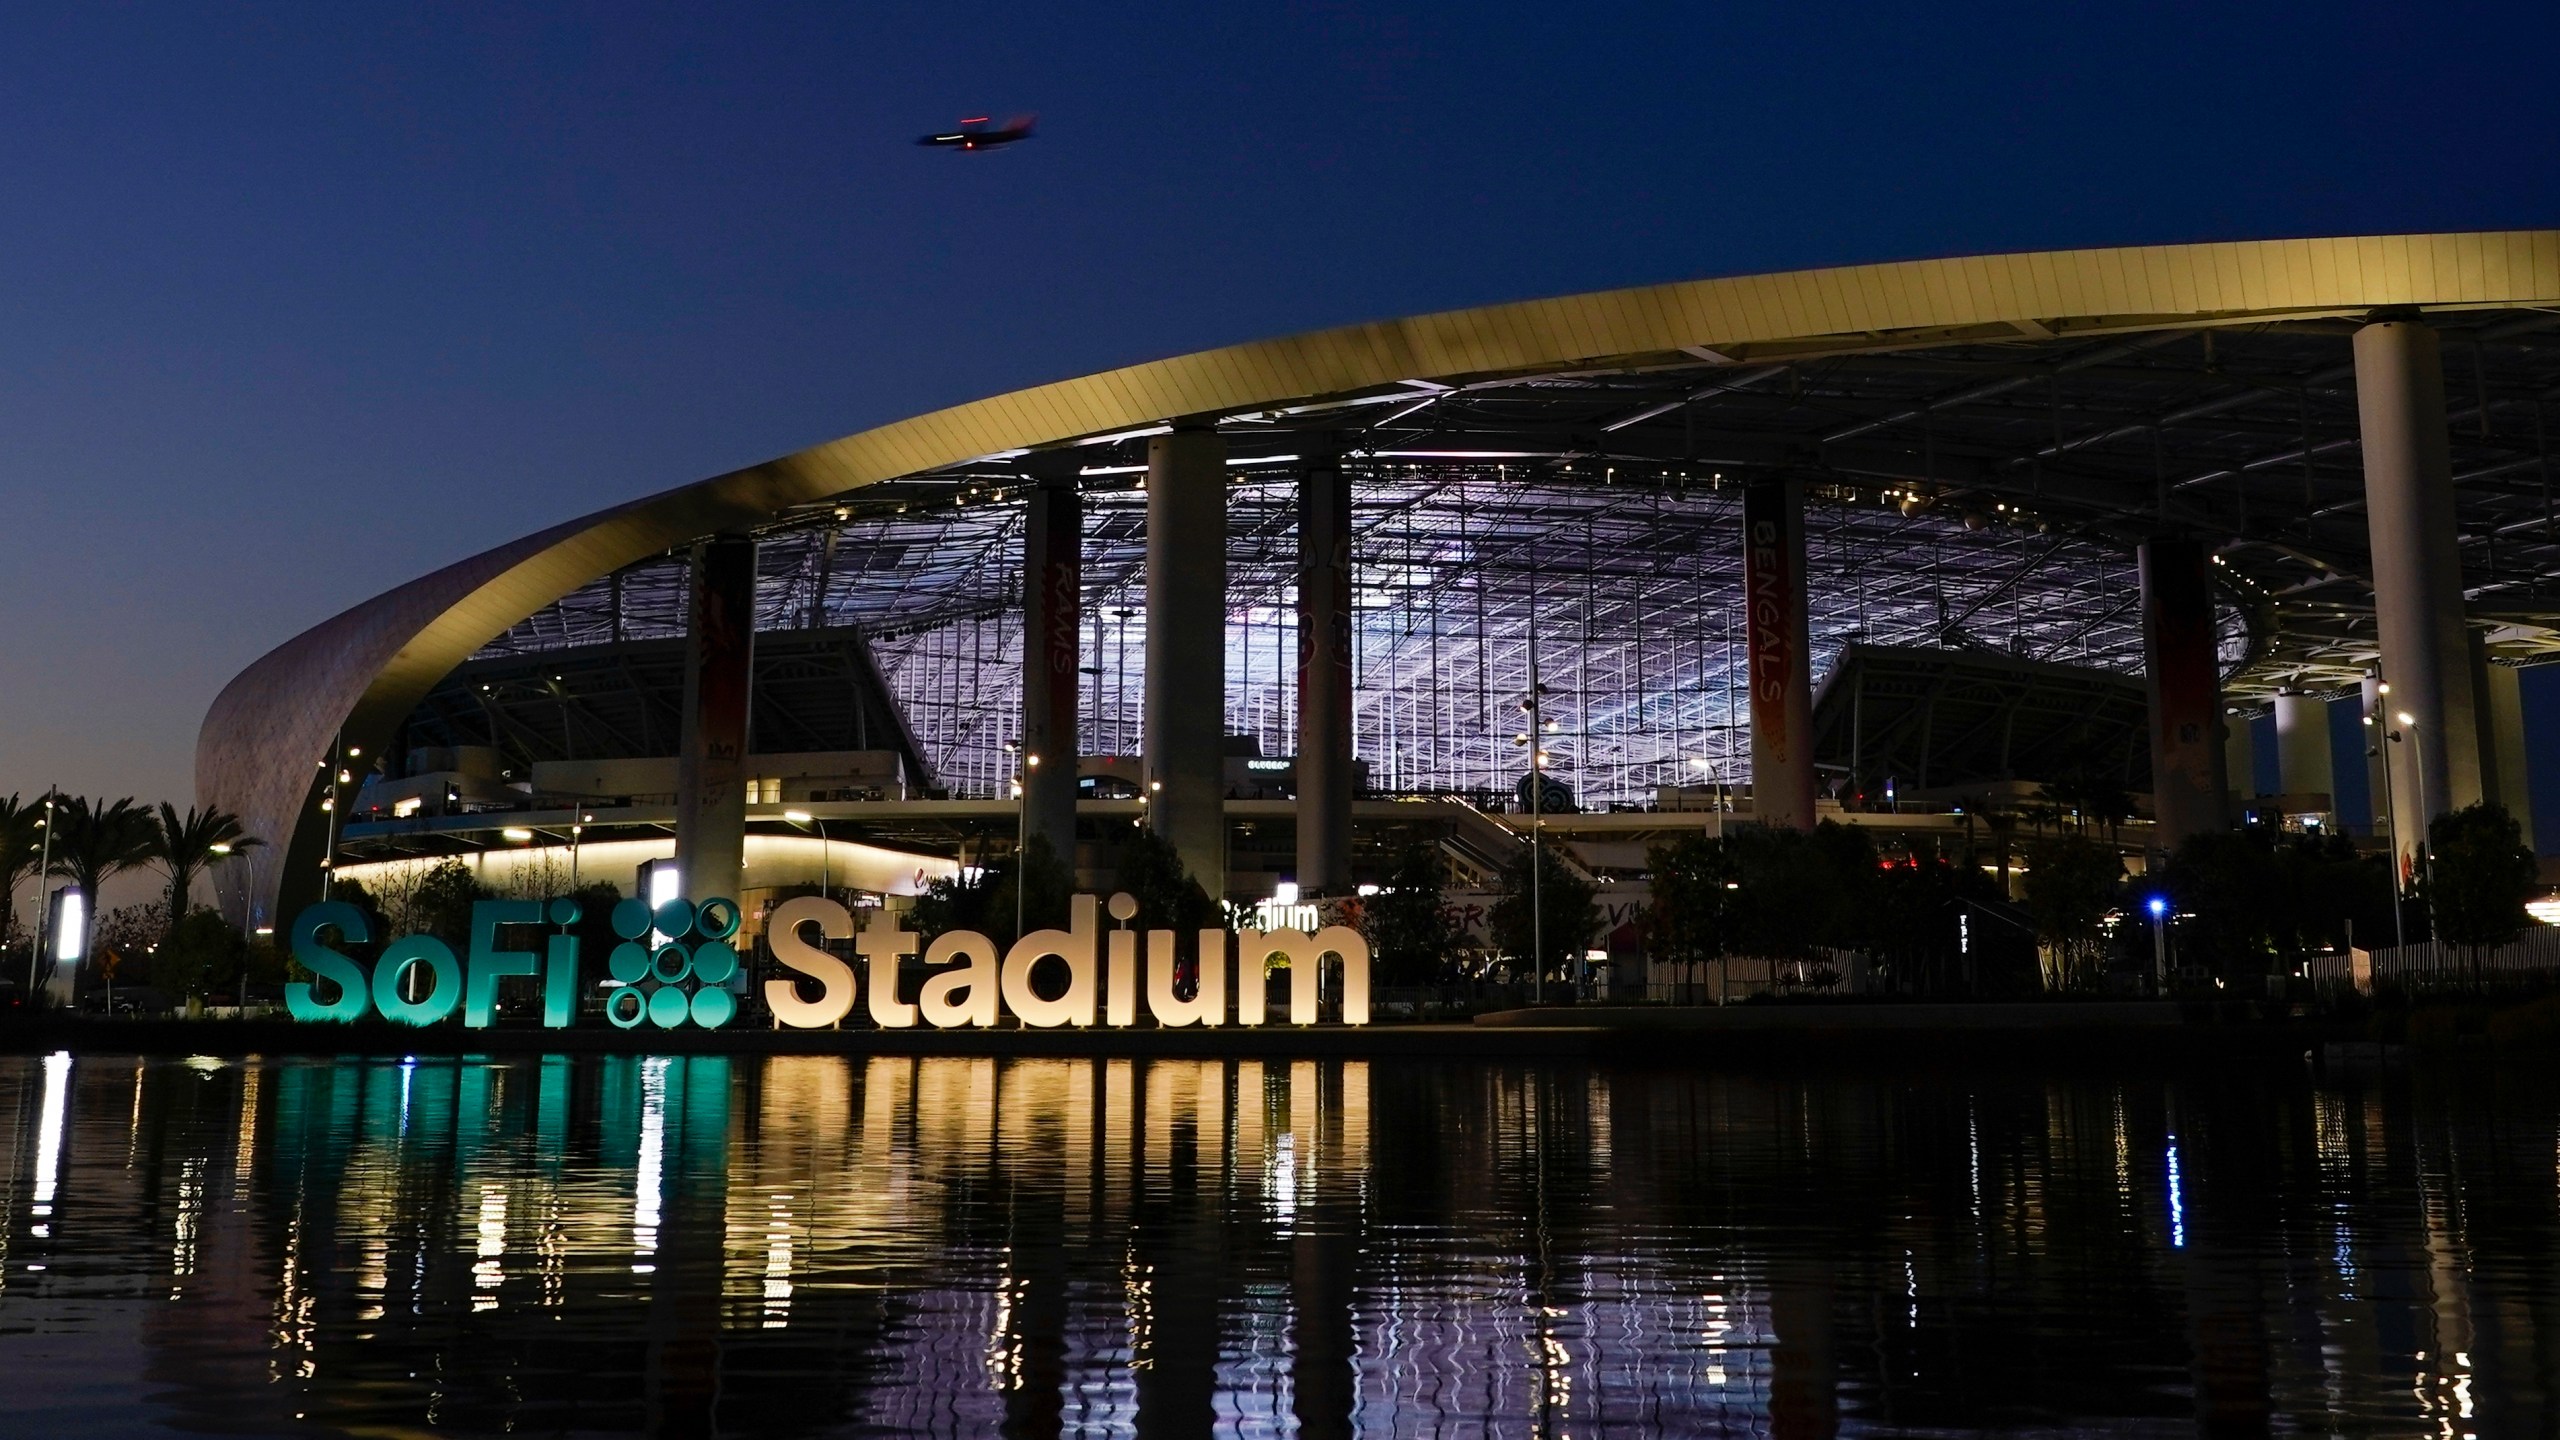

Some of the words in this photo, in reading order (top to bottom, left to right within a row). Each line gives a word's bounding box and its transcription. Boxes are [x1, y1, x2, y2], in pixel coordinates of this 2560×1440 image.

[1052, 561, 1074, 675] RAMS
[1753, 519, 1783, 703] BENGALS
[285, 896, 582, 1029] SoFi
[763, 892, 1371, 1029] Stadium
